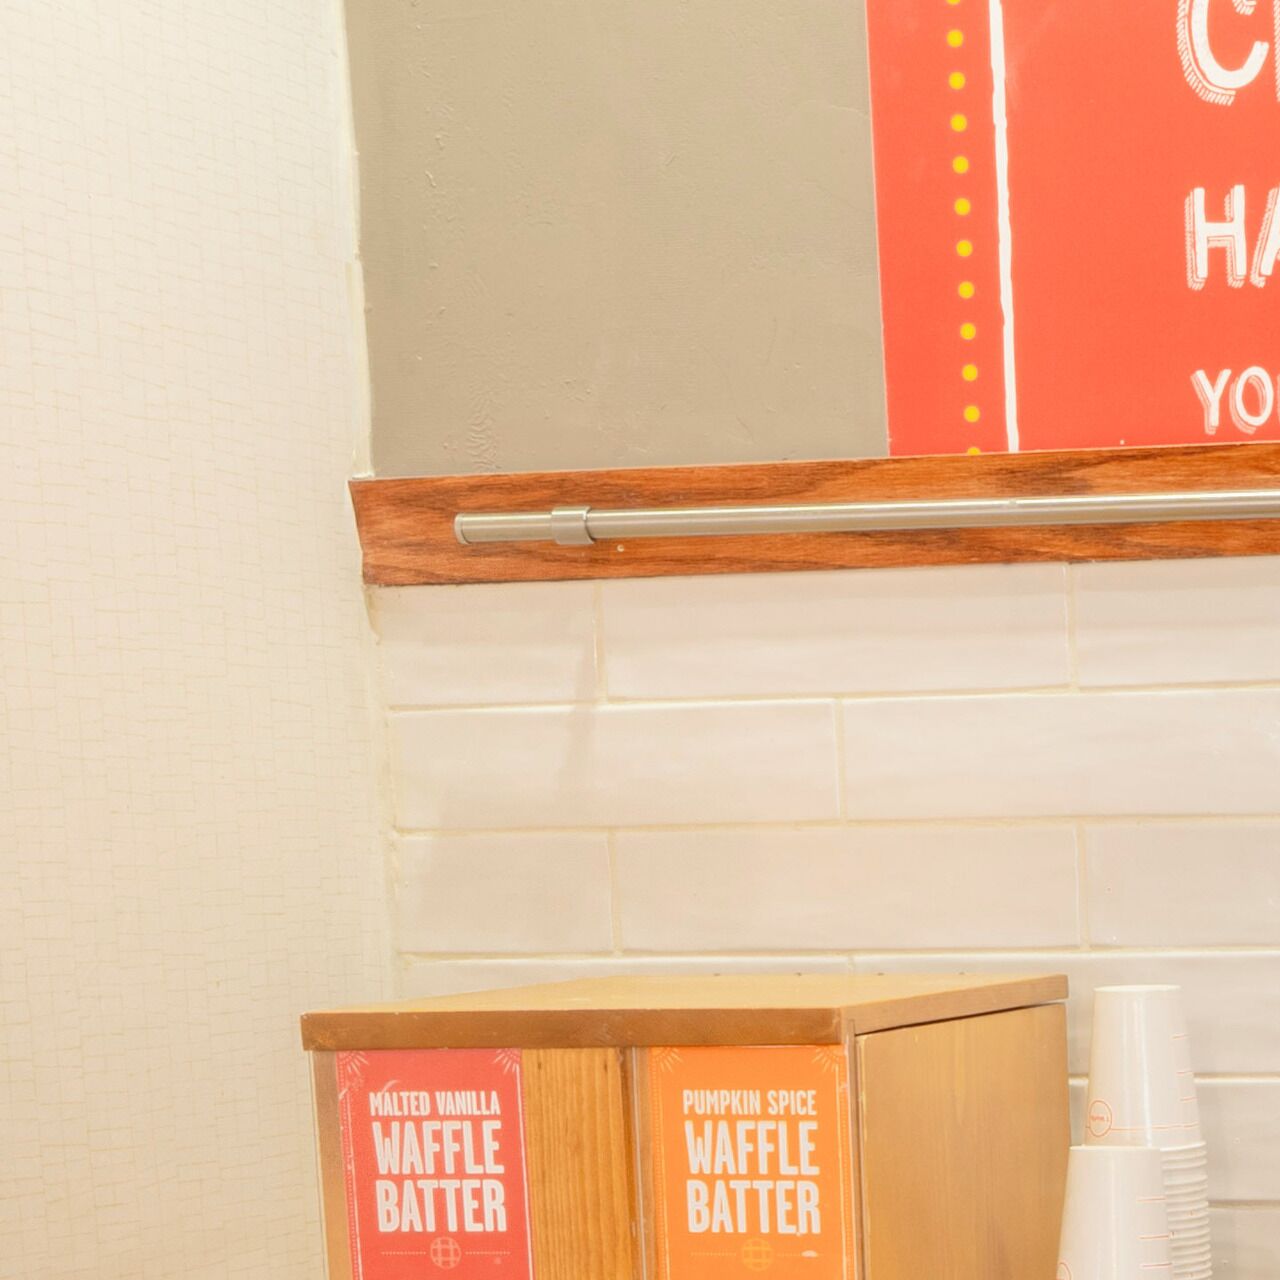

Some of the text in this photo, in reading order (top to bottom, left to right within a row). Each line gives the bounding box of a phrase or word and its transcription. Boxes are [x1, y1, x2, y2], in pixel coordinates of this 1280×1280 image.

[369, 1090, 501, 1116] MALTED VANILLA
[682, 1090, 818, 1116] PUMPKIN SPICE
[372, 1120, 505, 1175] WAFFLE
[684, 1120, 821, 1175] WAFFLE
[375, 1179, 508, 1233] BATTER
[686, 1180, 821, 1235] BATTER
